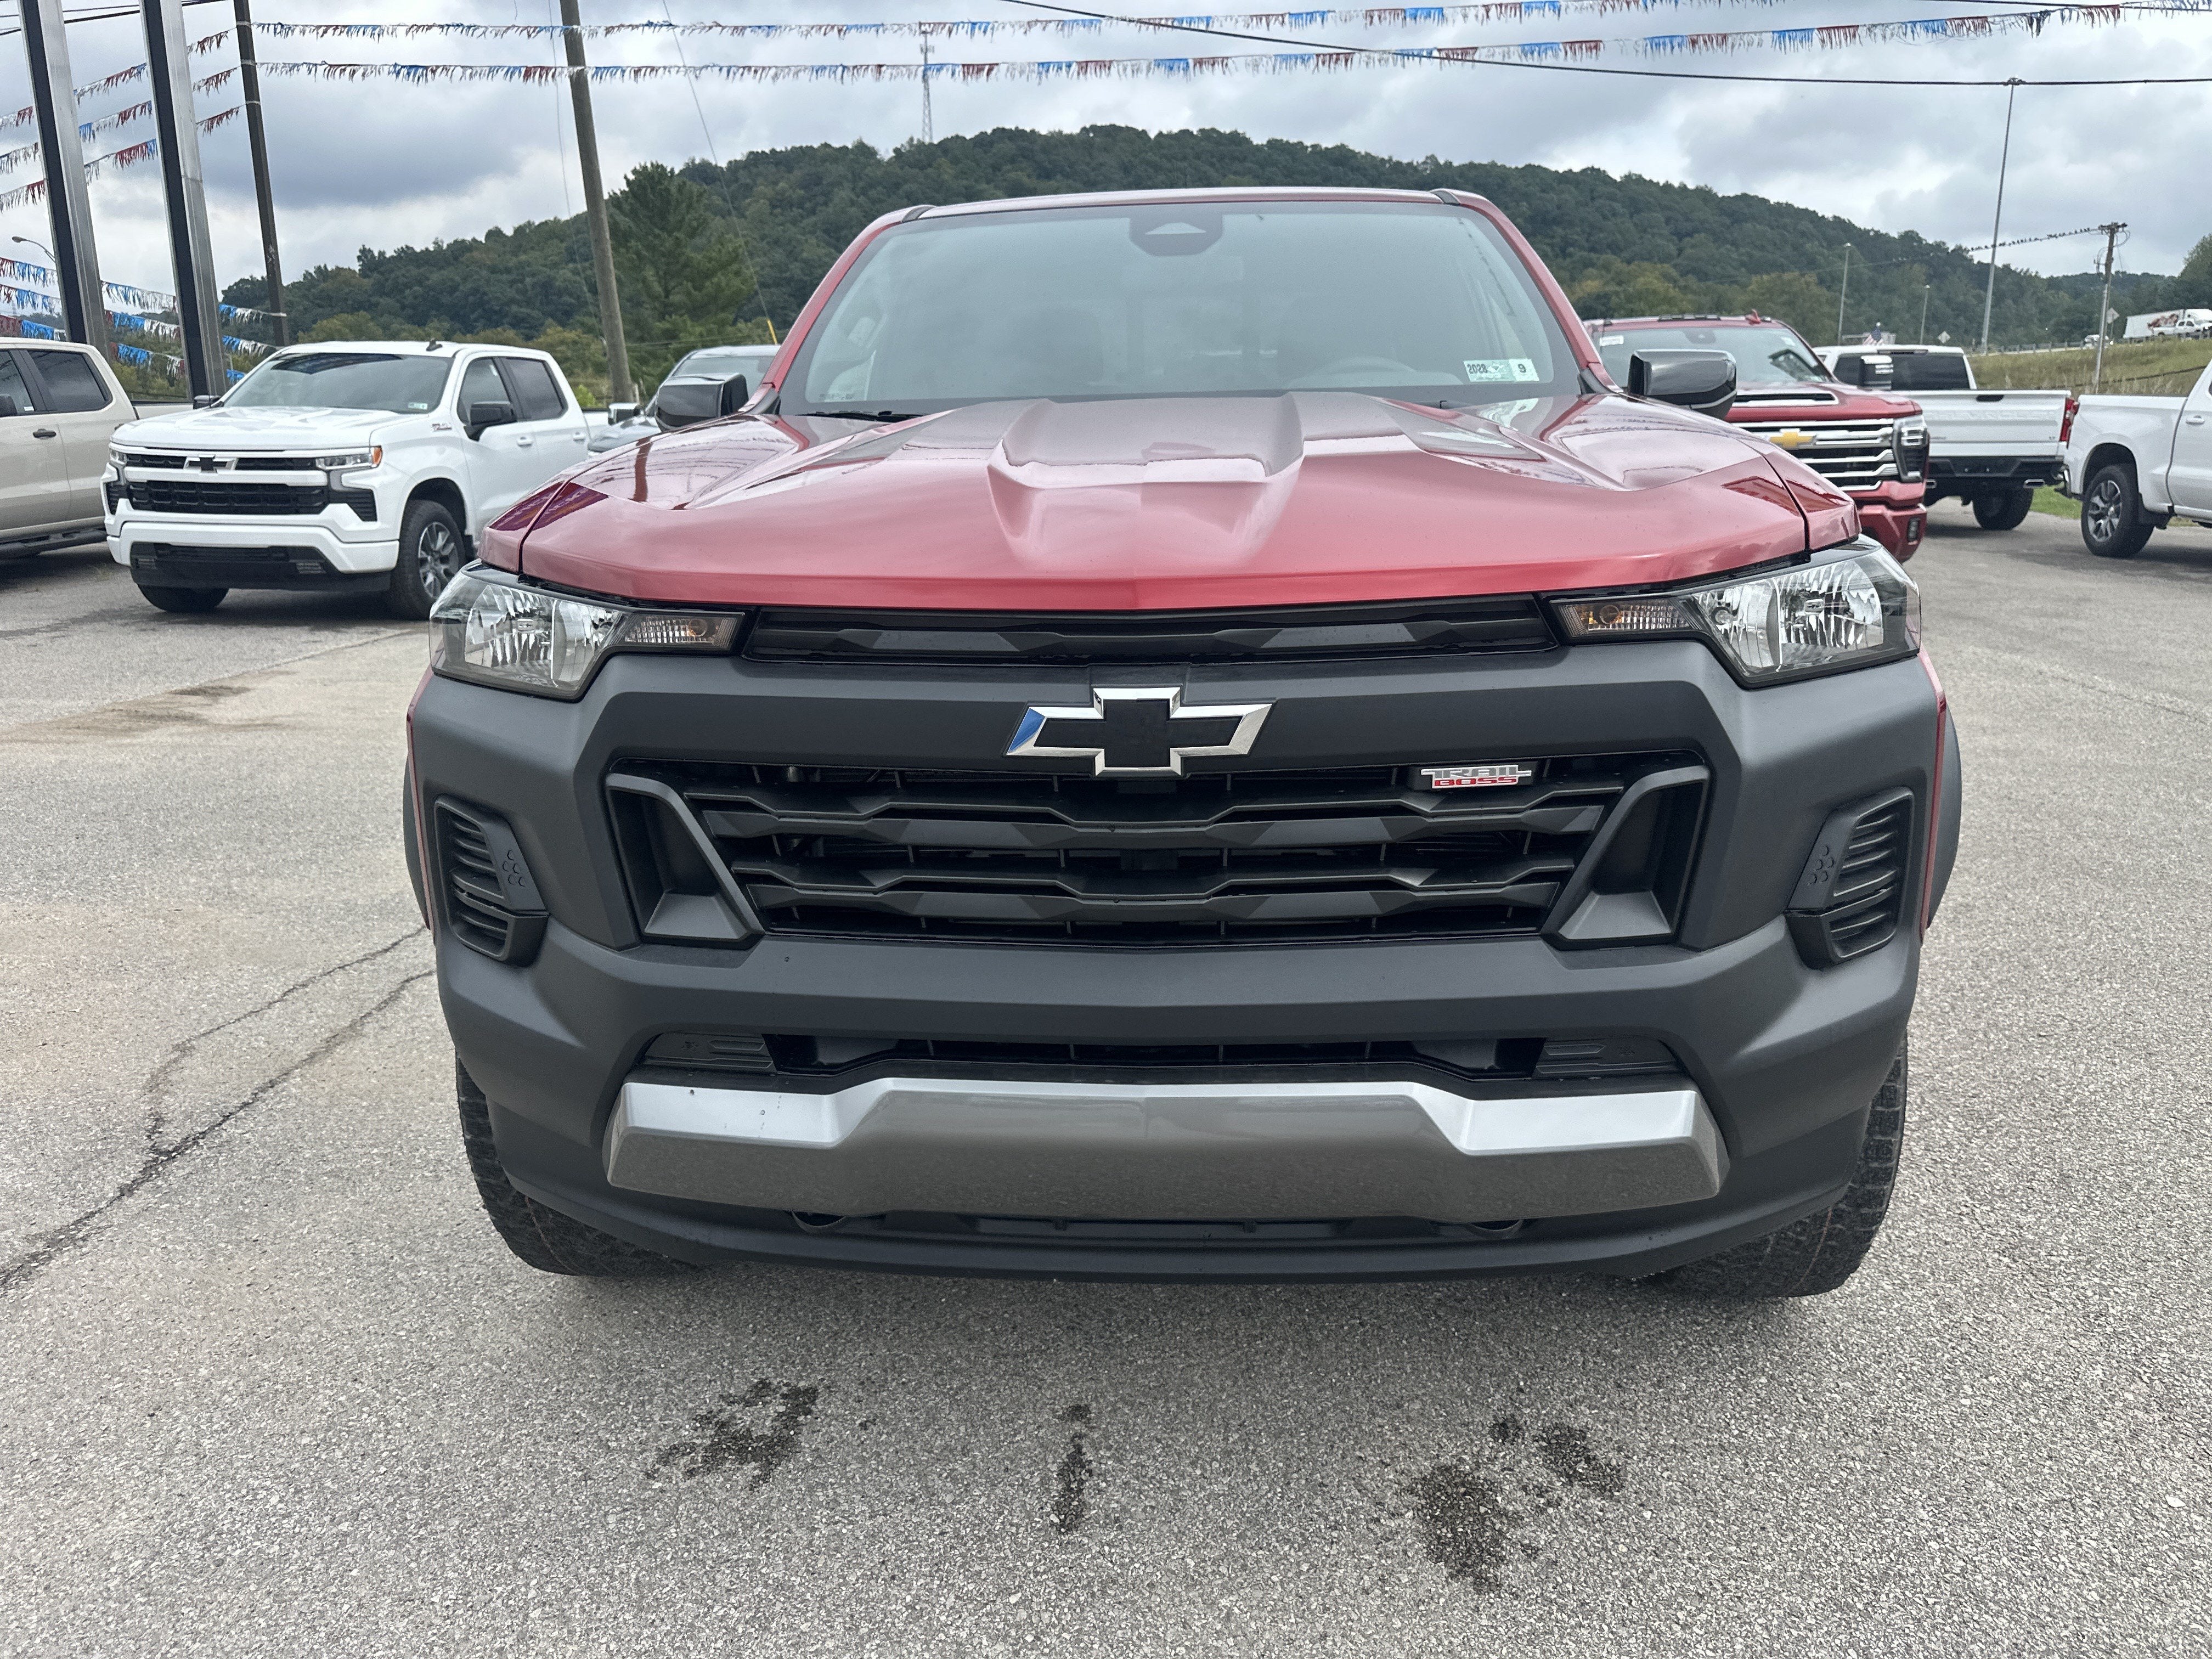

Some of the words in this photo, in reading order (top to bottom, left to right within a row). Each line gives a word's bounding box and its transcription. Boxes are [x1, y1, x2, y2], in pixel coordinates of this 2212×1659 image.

[1467, 363, 1488, 374] 2028
[1517, 364, 1526, 373] 9
[1421, 765, 1532, 778] TRAIL
[1434, 776, 1517, 787] BOSS
